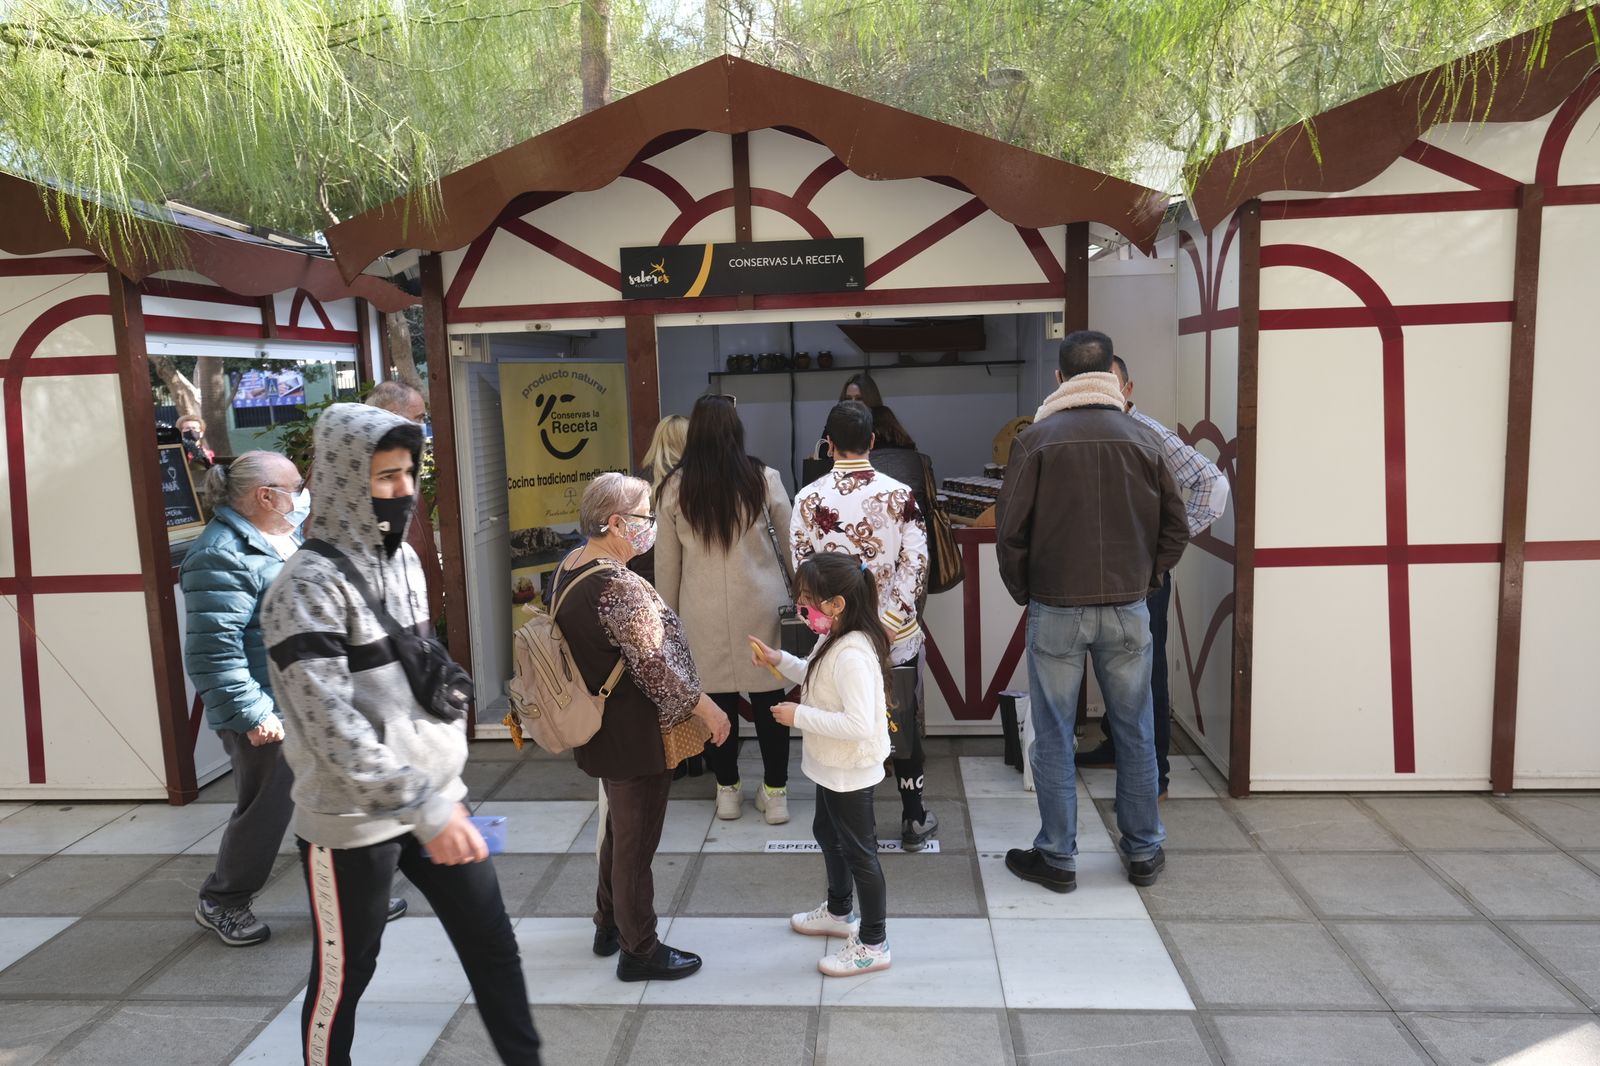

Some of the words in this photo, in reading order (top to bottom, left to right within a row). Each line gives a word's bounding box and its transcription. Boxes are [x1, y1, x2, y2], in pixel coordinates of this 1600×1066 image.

[728, 257, 788, 268] CONSERVAS
[790, 256, 803, 266] LA
[805, 254, 844, 265] RECETA
[522, 370, 569, 399] producto
[571, 371, 607, 395] natural
[551, 411, 591, 420] Conservas
[592, 410, 600, 418] la
[552, 420, 598, 434] Receta
[507, 476, 535, 490] Cocina
[537, 470, 578, 486] tradicional
